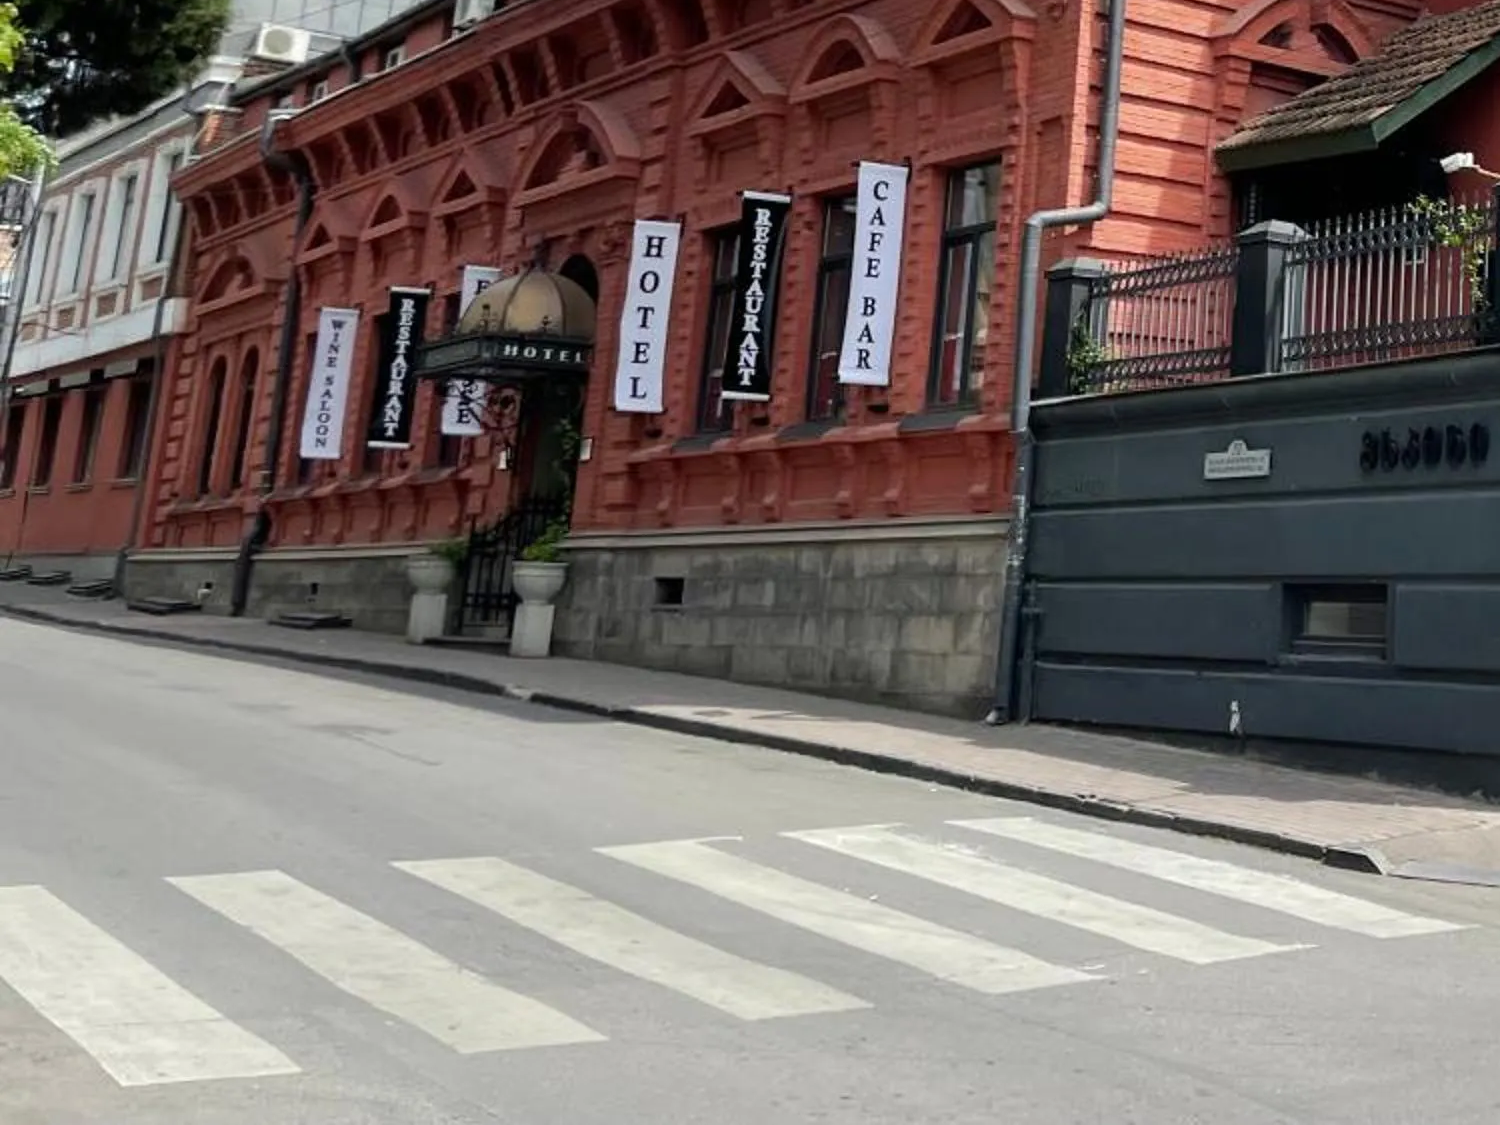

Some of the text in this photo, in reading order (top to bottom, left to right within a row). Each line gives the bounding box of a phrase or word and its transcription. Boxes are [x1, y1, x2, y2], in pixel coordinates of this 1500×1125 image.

[629, 235, 667, 400] HOTEL
[737, 208, 773, 386] RESTAURANT
[856, 180, 889, 370] CAFE BAR
[314, 319, 347, 448] WINE SALOON
[383, 298, 416, 437] RESTAURANT
[503, 344, 583, 364] HOTEL
